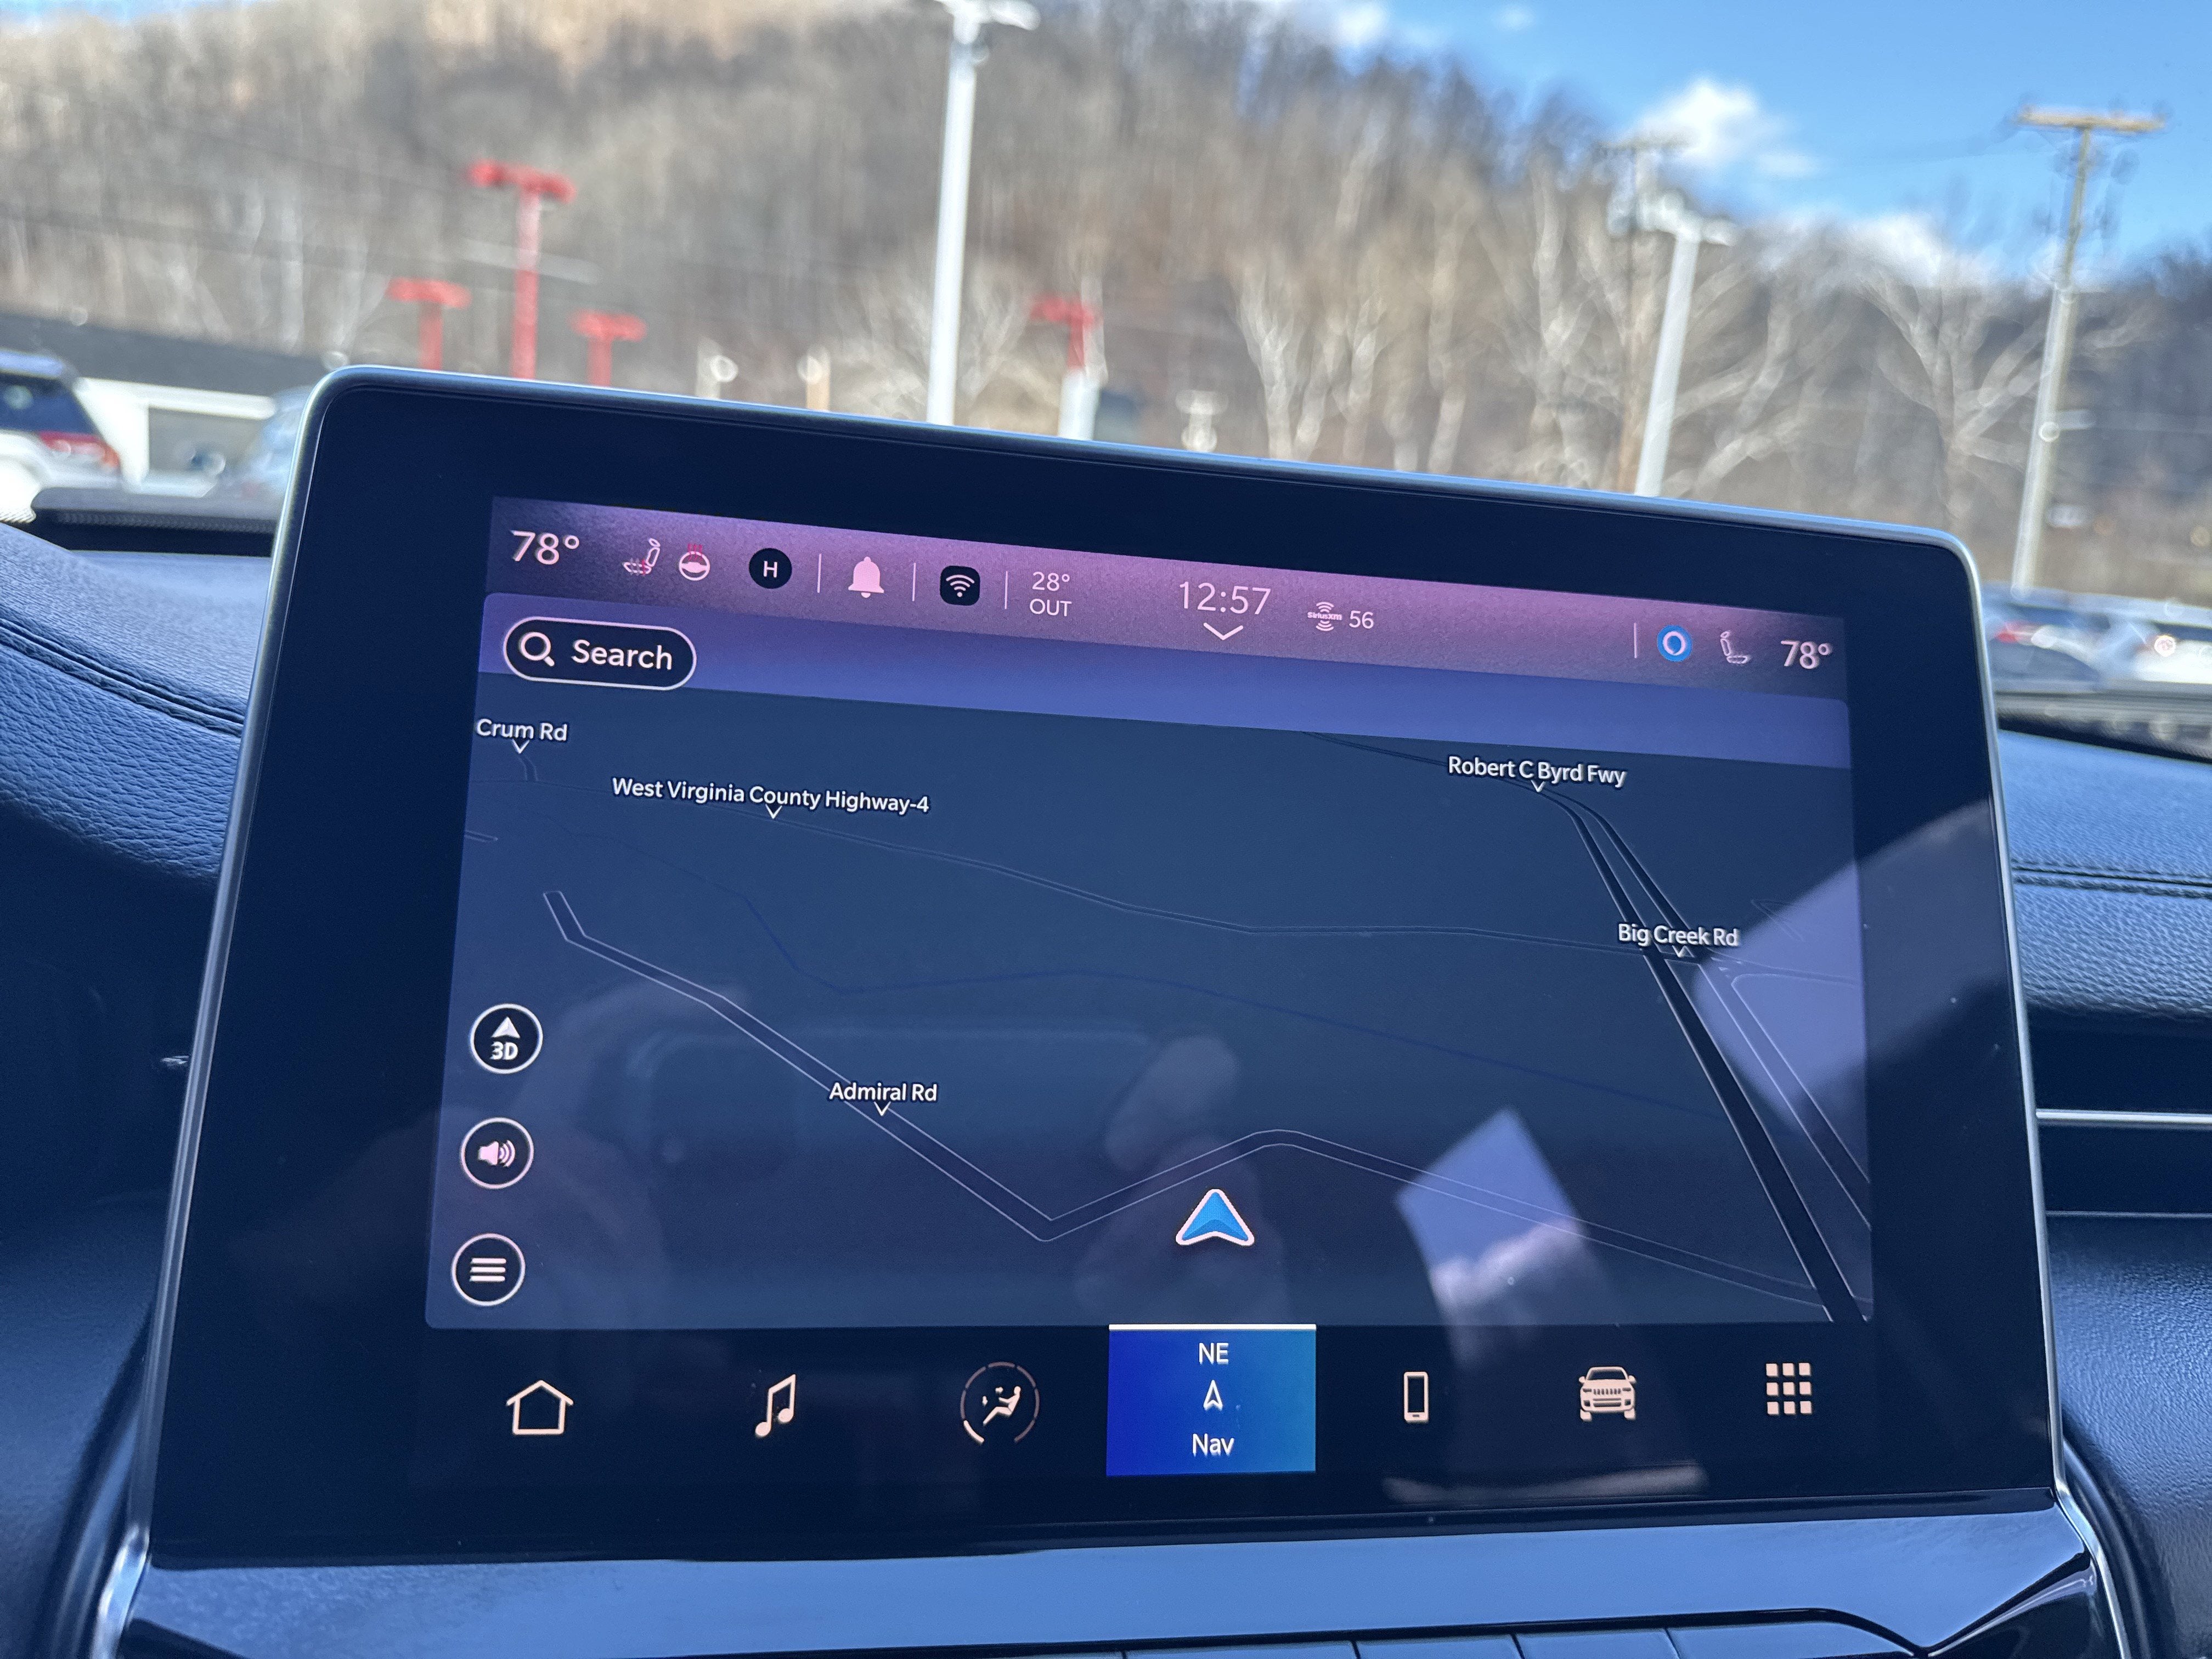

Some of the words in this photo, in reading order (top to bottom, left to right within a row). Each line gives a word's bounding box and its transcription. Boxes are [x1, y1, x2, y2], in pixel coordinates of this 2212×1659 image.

[511, 529, 580, 565] 78°
[763, 561, 778, 578] H
[1031, 571, 1071, 592] 28°
[1029, 599, 1072, 618] OUT
[1178, 580, 1272, 616] 12:57
[1348, 610, 1374, 629] 56
[571, 639, 673, 672] Search
[1780, 639, 1833, 670] 78°
[476, 718, 534, 740] Crum
[539, 722, 568, 742] Rd
[1449, 756, 1516, 777] Robert
[1519, 760, 1534, 778] C
[1538, 761, 1583, 784] Byrd
[1587, 765, 1627, 788] Fwy
[612, 777, 663, 798] West
[667, 781, 744, 804] Virginia
[749, 785, 821, 809] County
[825, 790, 929, 815] Highway-4
[1618, 923, 1649, 946] Big
[1653, 926, 1709, 946] Creek
[1713, 928, 1739, 947] Rd
[490, 1042, 519, 1061] 3D
[829, 1081, 906, 1103] Admiral
[911, 1084, 937, 1103] Rd
[1199, 1342, 1229, 1364] NE
[1192, 1434, 1234, 1457] Nav
